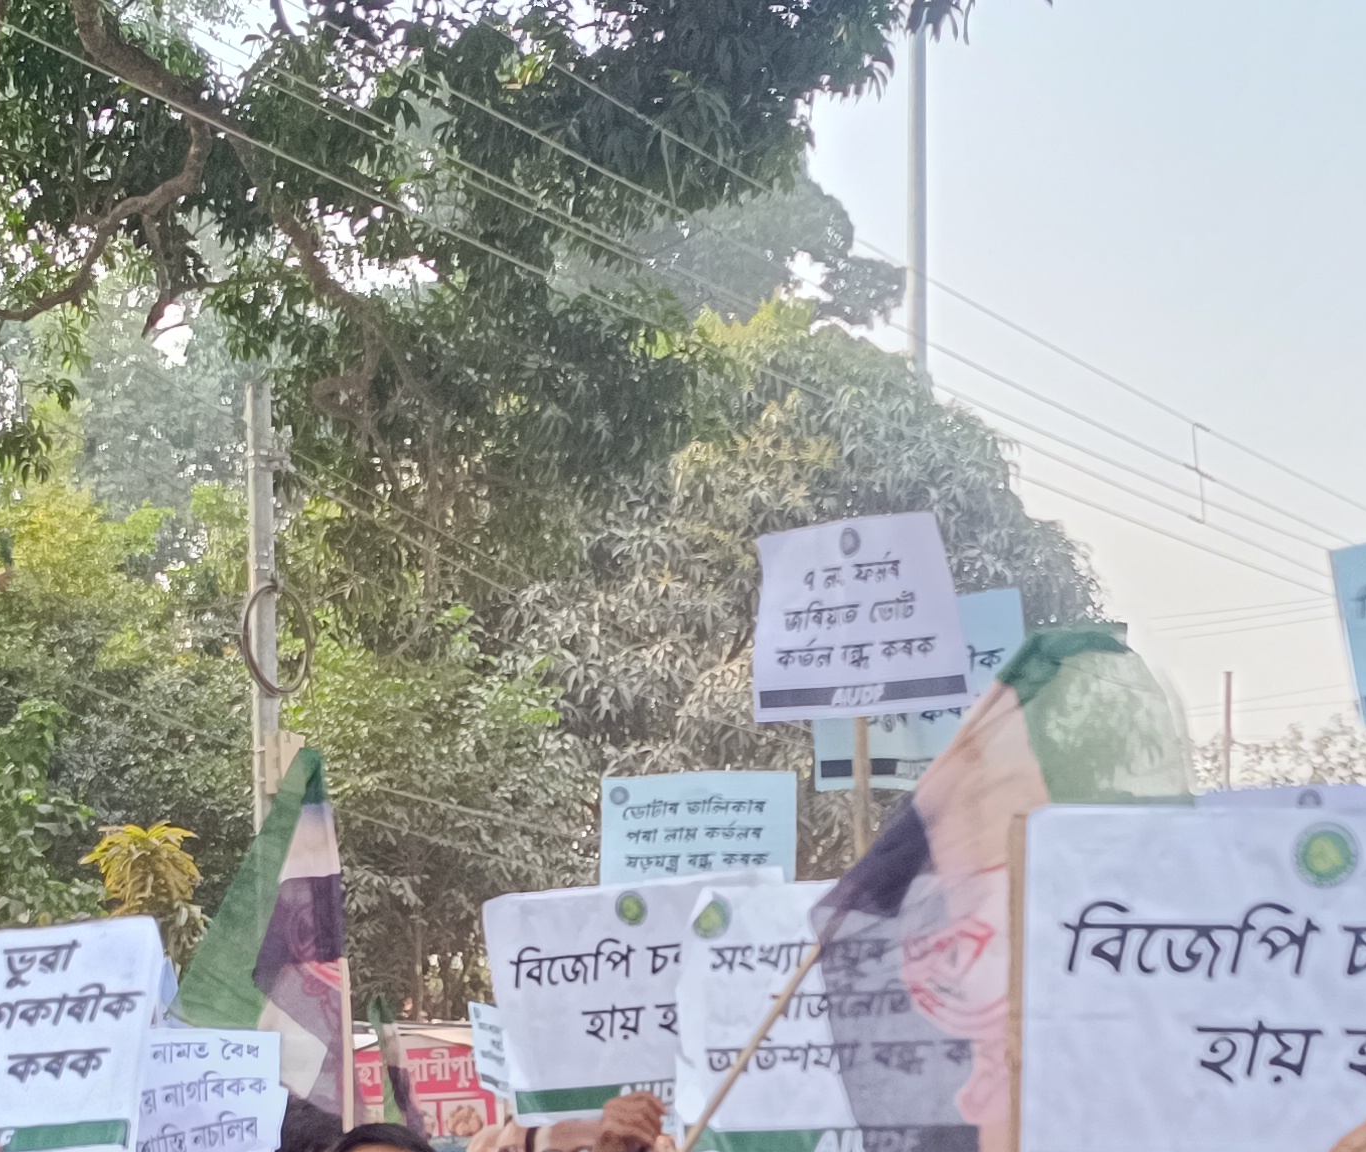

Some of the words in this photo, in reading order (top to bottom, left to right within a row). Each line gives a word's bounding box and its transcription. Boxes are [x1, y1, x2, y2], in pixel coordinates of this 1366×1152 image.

[510, 938, 635, 989] বিজেপি
[1063, 899, 1321, 979] বিজেপি
[582, 1003, 645, 1043] হায়
[7, 1047, 111, 1083] কৰক
[1196, 1020, 1322, 1086] হায়
